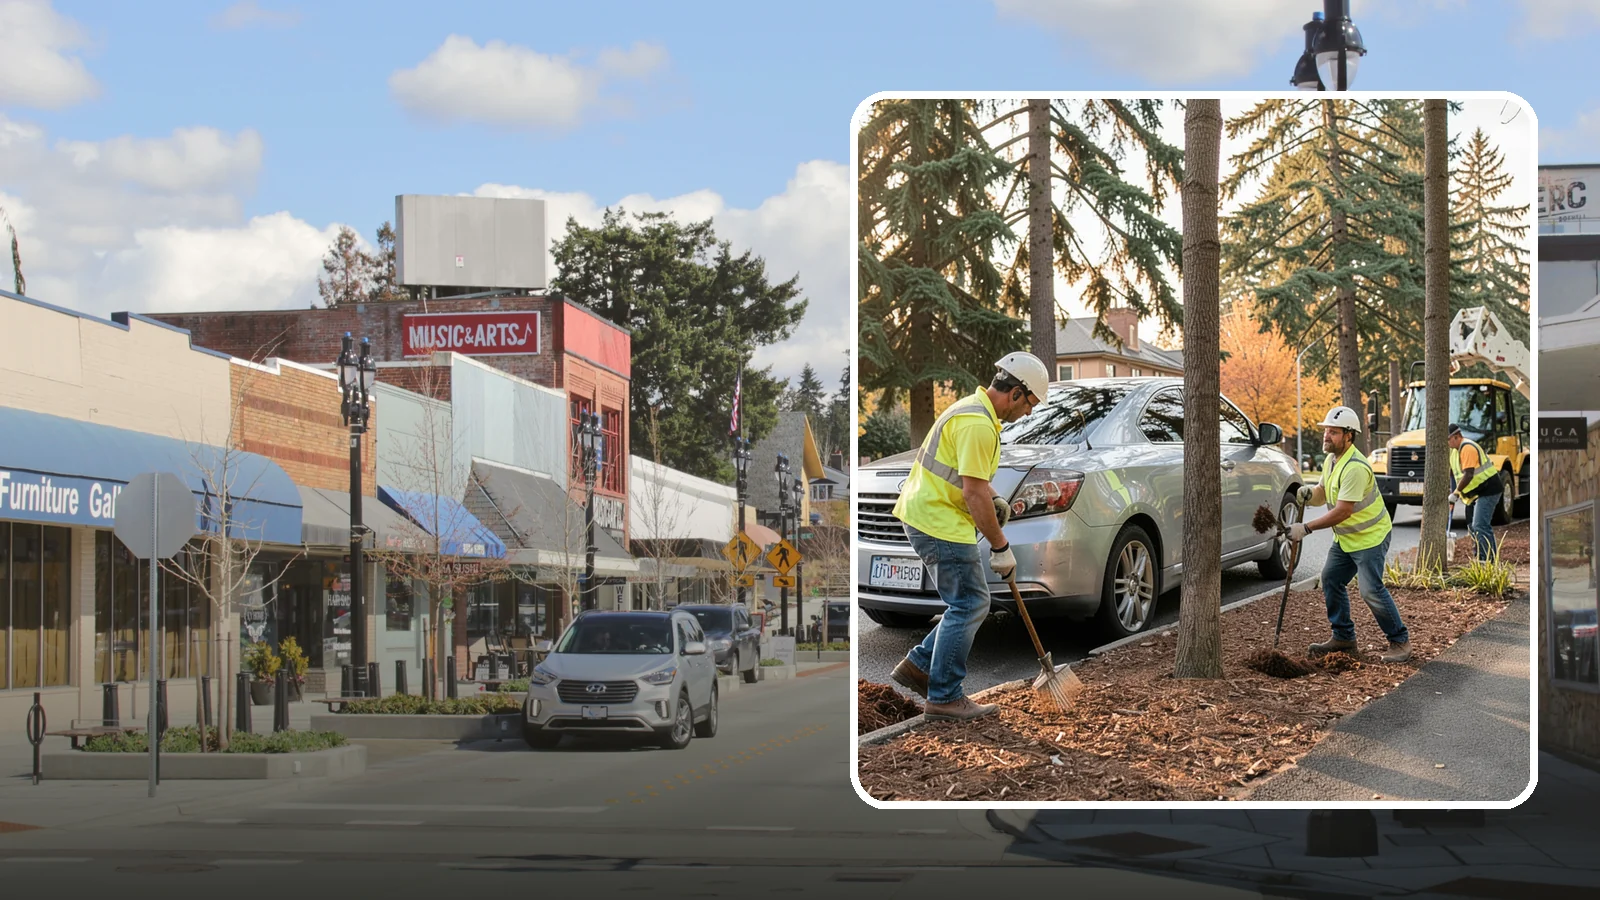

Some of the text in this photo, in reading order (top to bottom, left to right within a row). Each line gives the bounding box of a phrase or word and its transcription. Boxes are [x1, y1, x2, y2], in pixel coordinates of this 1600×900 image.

[408, 322, 520, 349] MUSIC&ARTS
[0, 471, 122, 519] Furniture Gal
